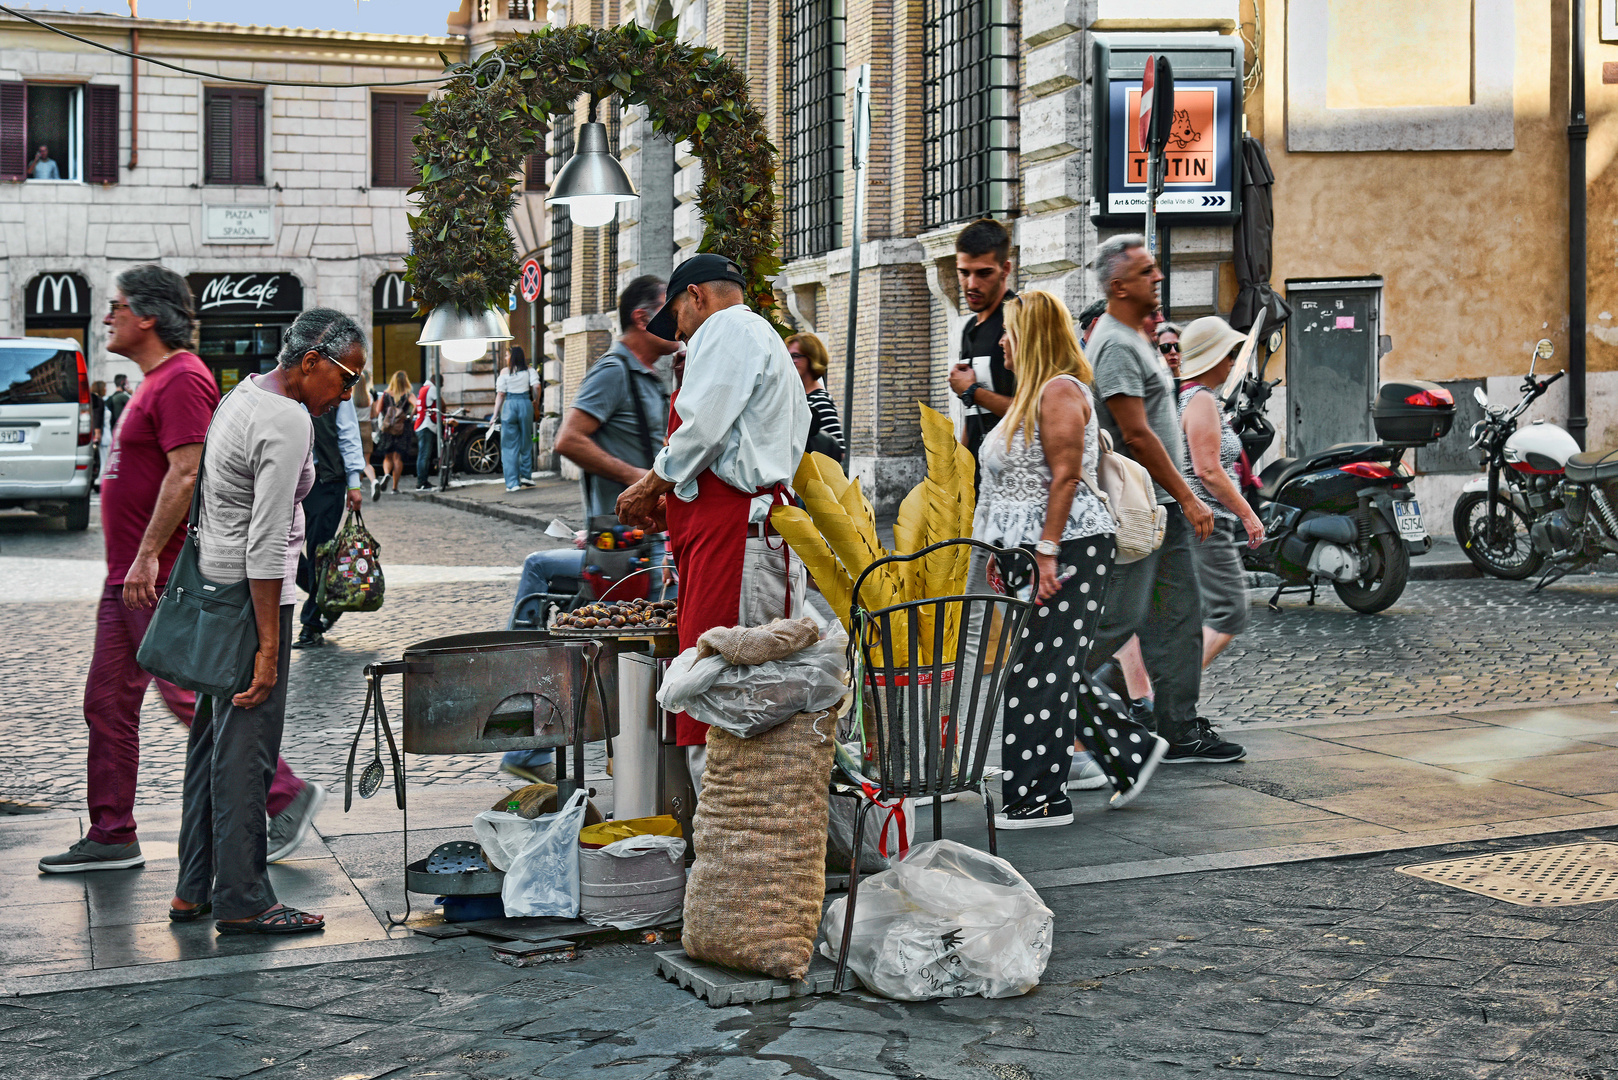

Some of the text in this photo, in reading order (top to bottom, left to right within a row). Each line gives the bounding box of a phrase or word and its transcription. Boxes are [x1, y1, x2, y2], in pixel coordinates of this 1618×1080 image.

[1134, 158, 1206, 177] TTIN
[225, 210, 254, 219] PIAZZA
[223, 227, 256, 236] SPAGNA
[1400, 502, 1411, 515] DK
[919, 967, 944, 991] OMA
